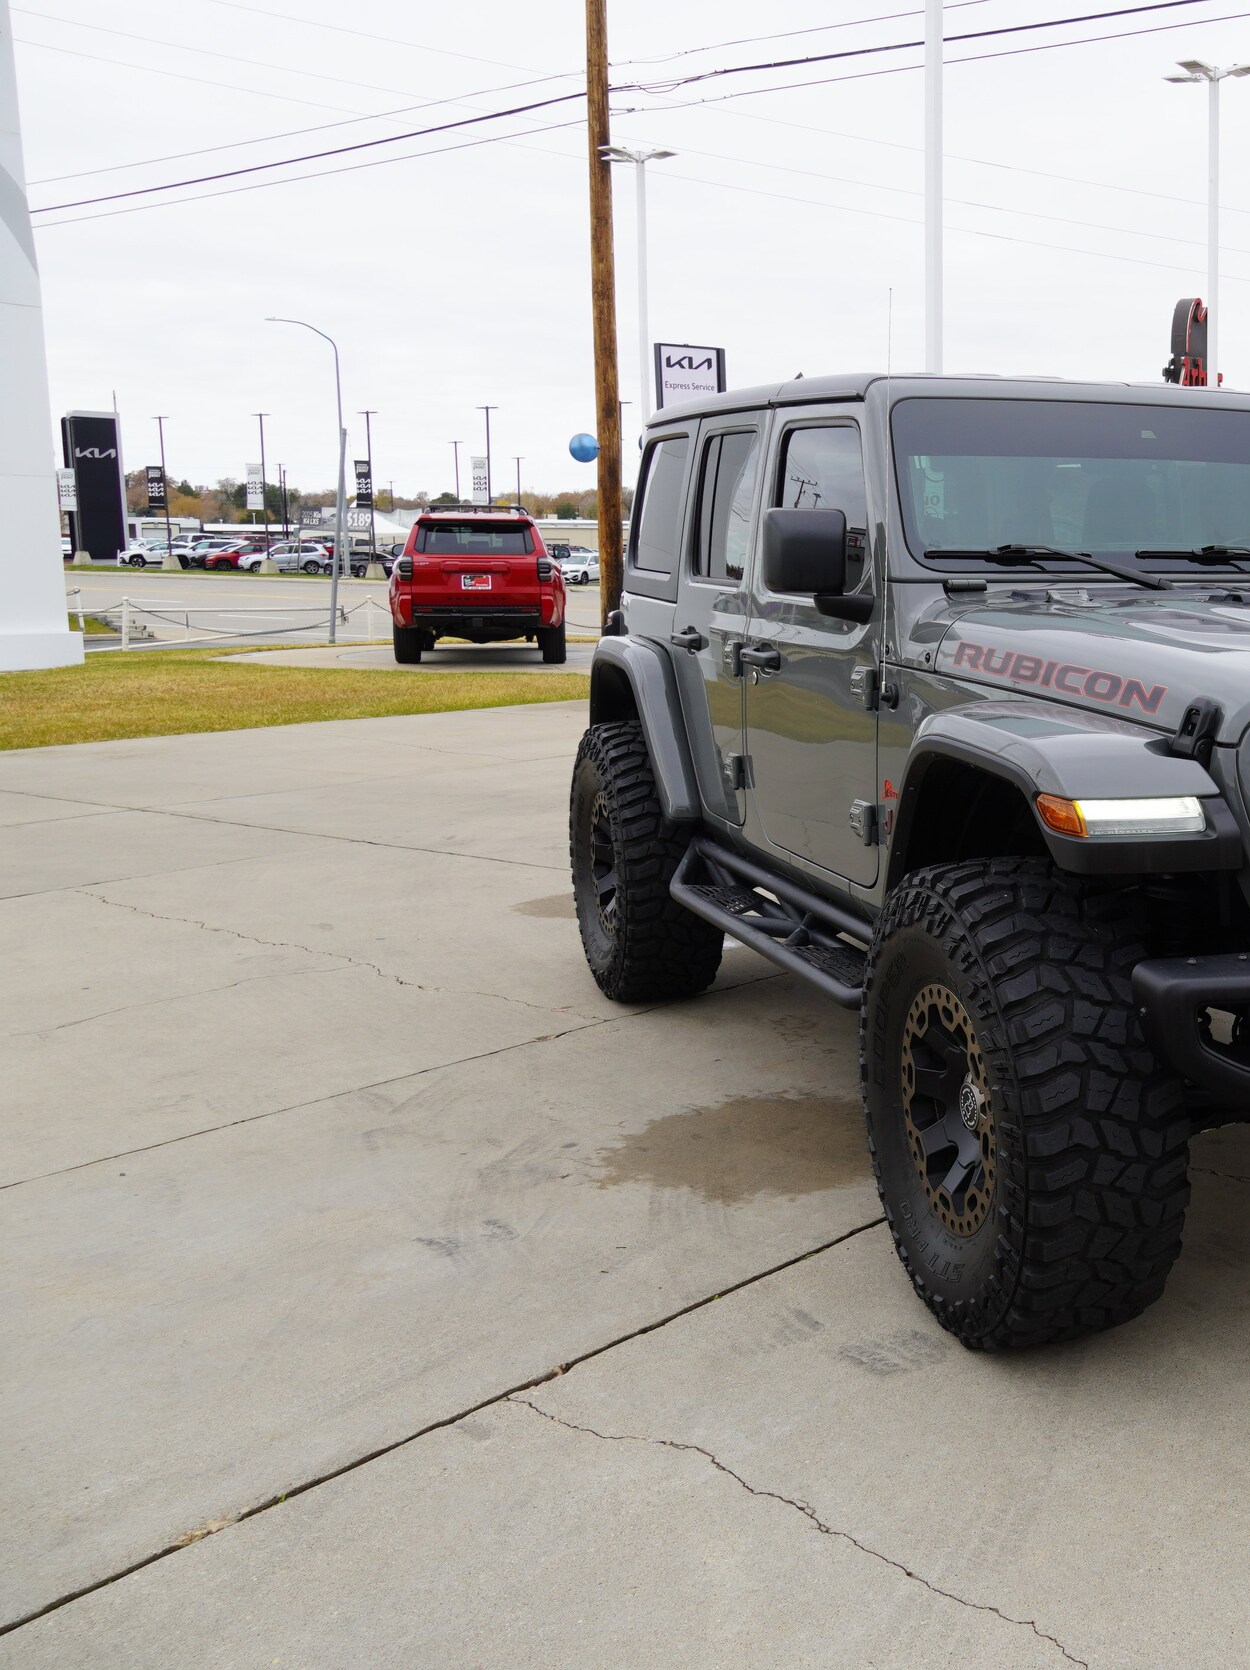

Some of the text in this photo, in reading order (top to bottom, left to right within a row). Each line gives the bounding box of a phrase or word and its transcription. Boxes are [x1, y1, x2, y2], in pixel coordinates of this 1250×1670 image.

[665, 355, 713, 370] KIA
[664, 381, 715, 392] Express Service
[75, 447, 117, 459] KIA
[347, 512, 371, 527] $189
[953, 641, 1168, 715] RUBICON
